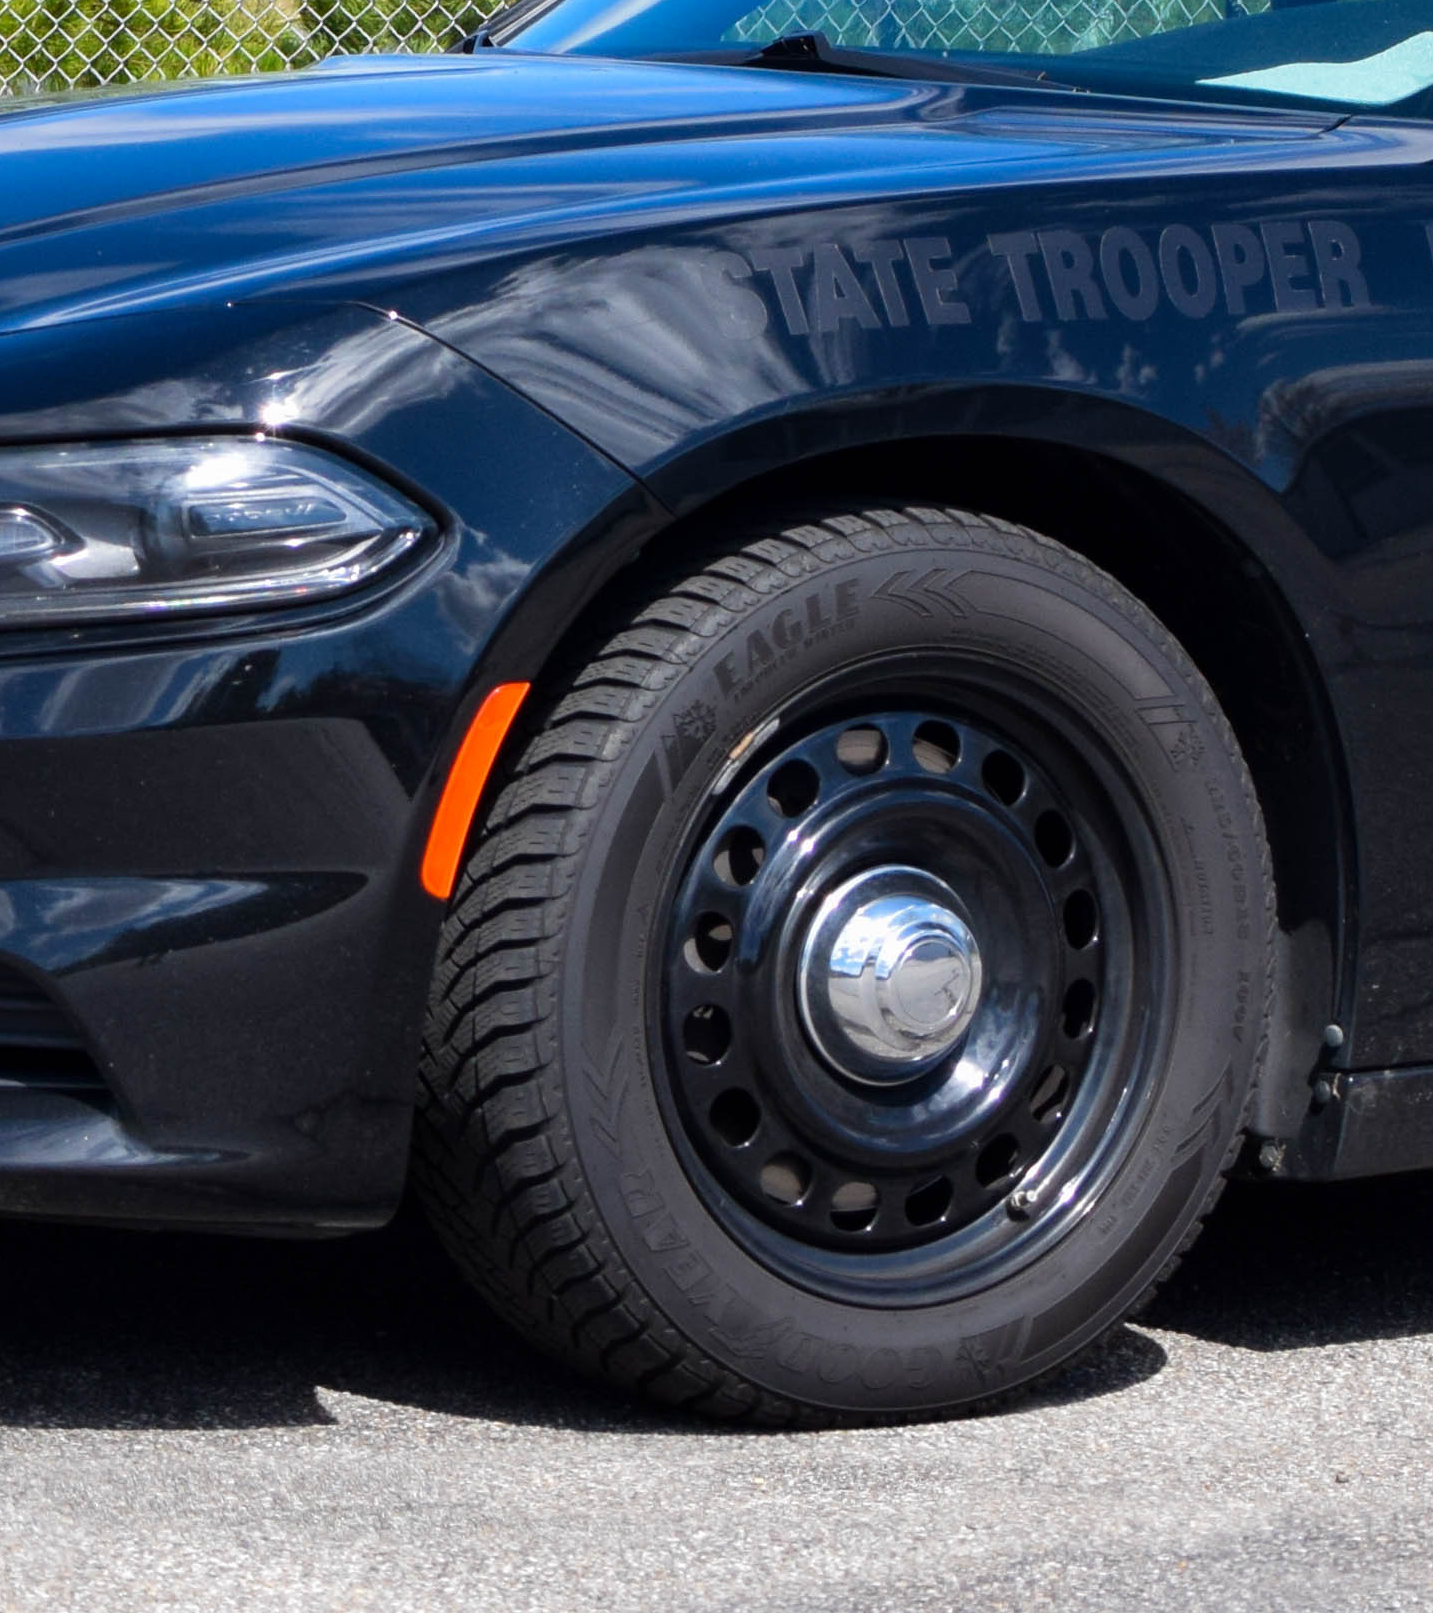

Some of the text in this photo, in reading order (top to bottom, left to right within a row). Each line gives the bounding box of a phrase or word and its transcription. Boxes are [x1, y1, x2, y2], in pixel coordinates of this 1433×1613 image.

[706, 219, 1369, 341] STATE TROOPER
[712, 577, 861, 699] EAGLE
